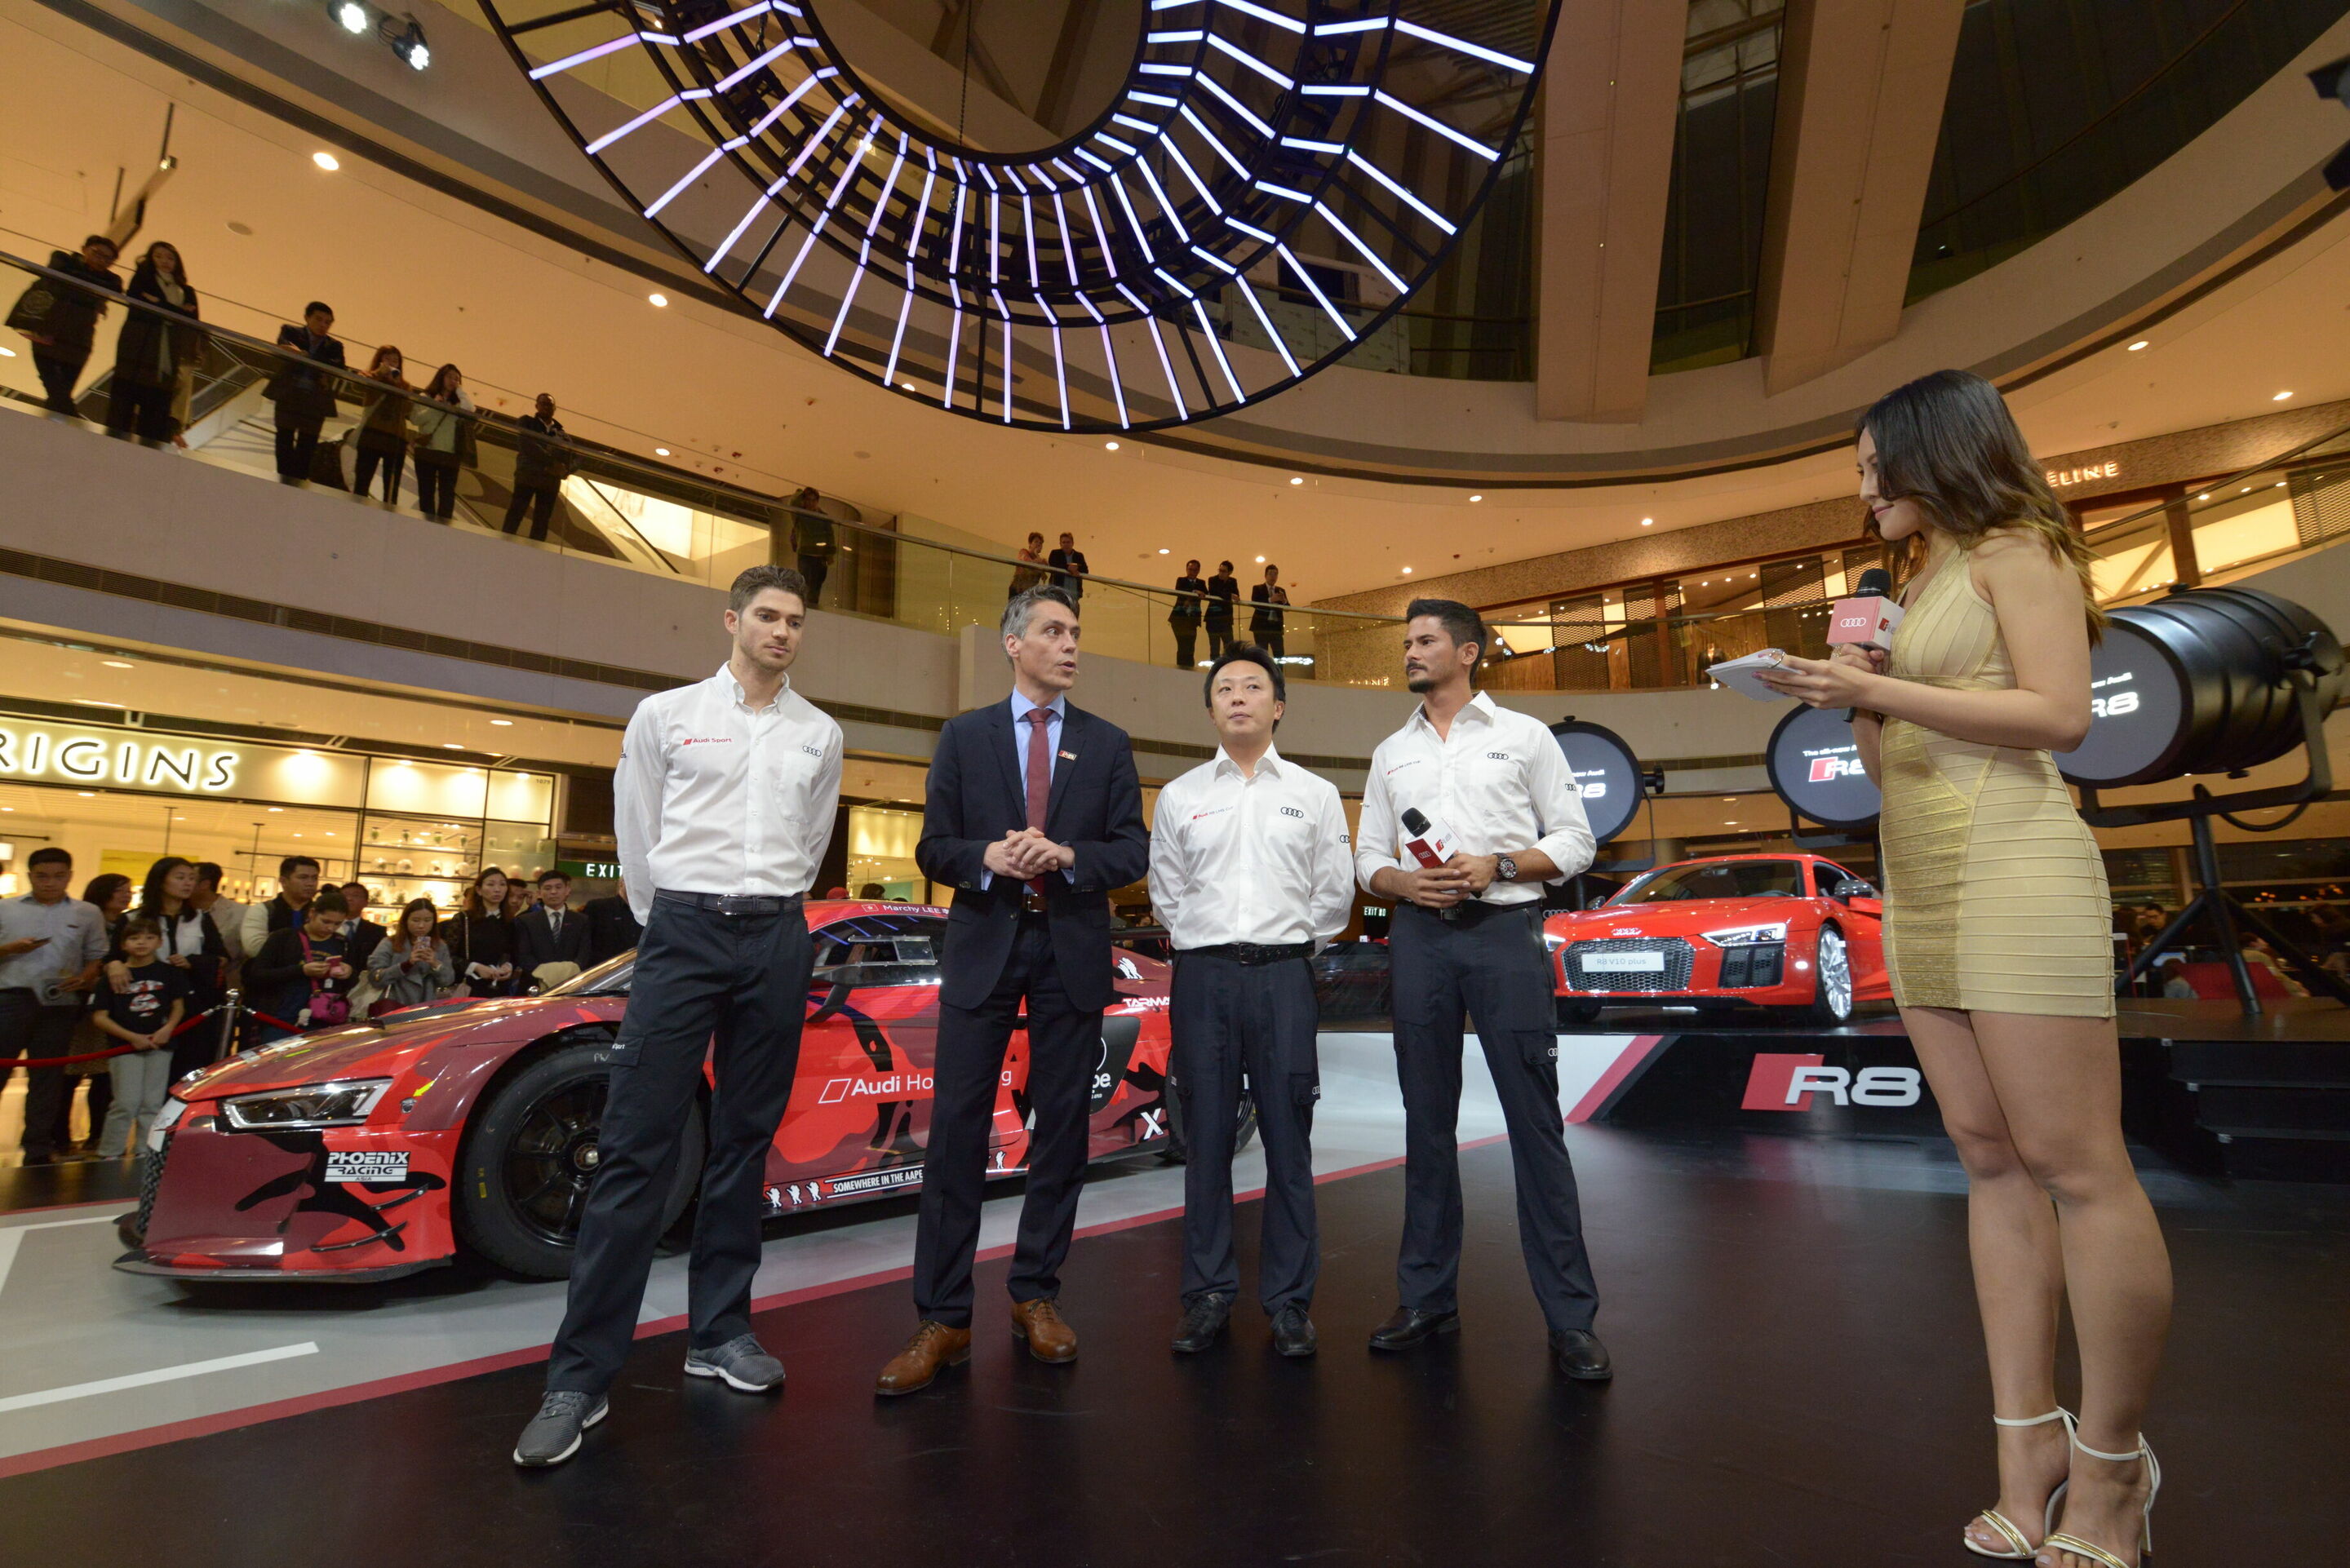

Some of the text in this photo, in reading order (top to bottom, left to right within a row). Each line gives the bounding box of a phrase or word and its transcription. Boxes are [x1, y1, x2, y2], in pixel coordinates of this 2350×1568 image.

[586, 863, 623, 878] EXIT
[882, 905, 920, 913] Marchy
[922, 906, 941, 915] LEE
[1363, 907, 1377, 916] EXIT
[1628, 958, 1647, 966] plus
[851, 1074, 933, 1096] Audi Ho
[1785, 1065, 1921, 1107] R8
[327, 1151, 410, 1165] PHOENIX
[833, 1169, 924, 1194] SOMEWHERE IN THE AAPE
